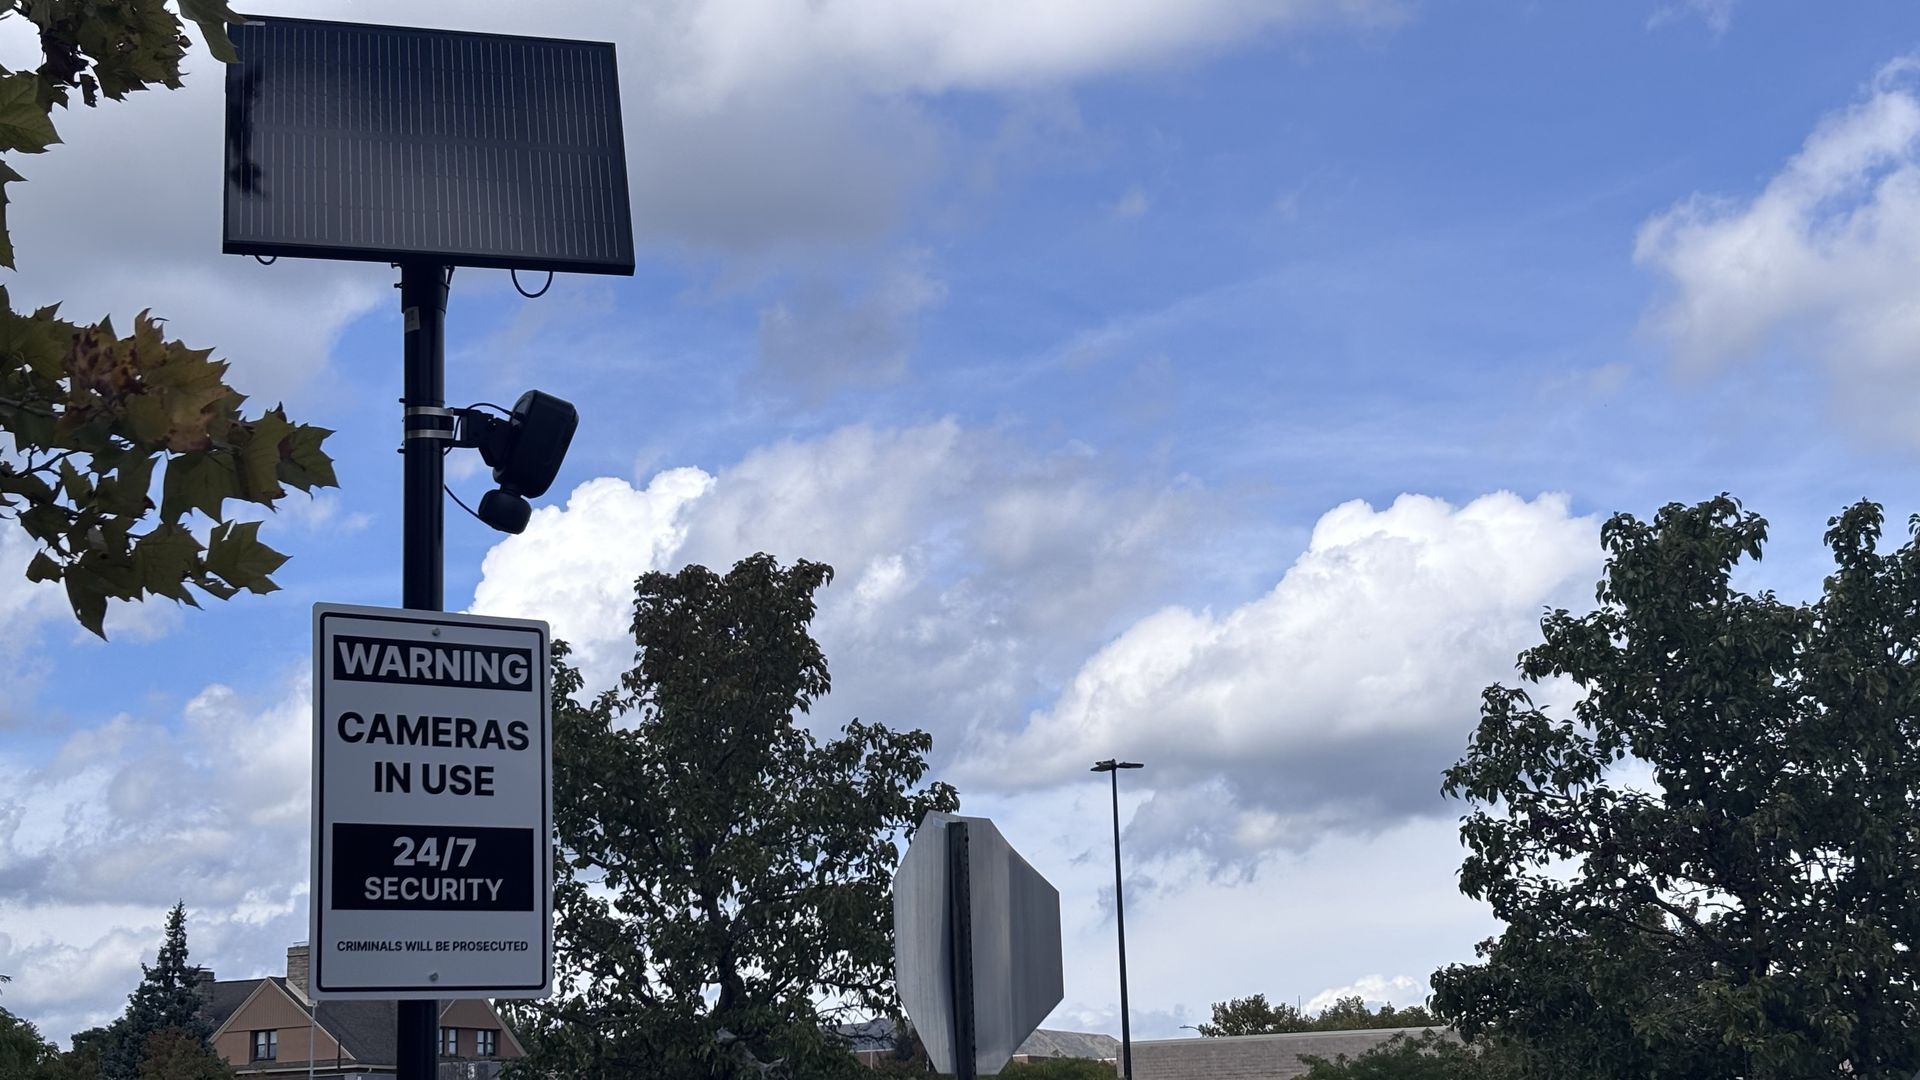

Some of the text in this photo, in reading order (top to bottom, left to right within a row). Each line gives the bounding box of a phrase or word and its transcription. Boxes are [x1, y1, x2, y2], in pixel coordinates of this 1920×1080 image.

[338, 642, 529, 686] WARNING
[337, 711, 530, 752] CAMERAS
[374, 761, 495, 797] IN USE
[393, 836, 477, 871] 24/7
[365, 877, 503, 901] SECURITY
[337, 941, 528, 952] CRIMINALS WILL BE PROSECUTED
